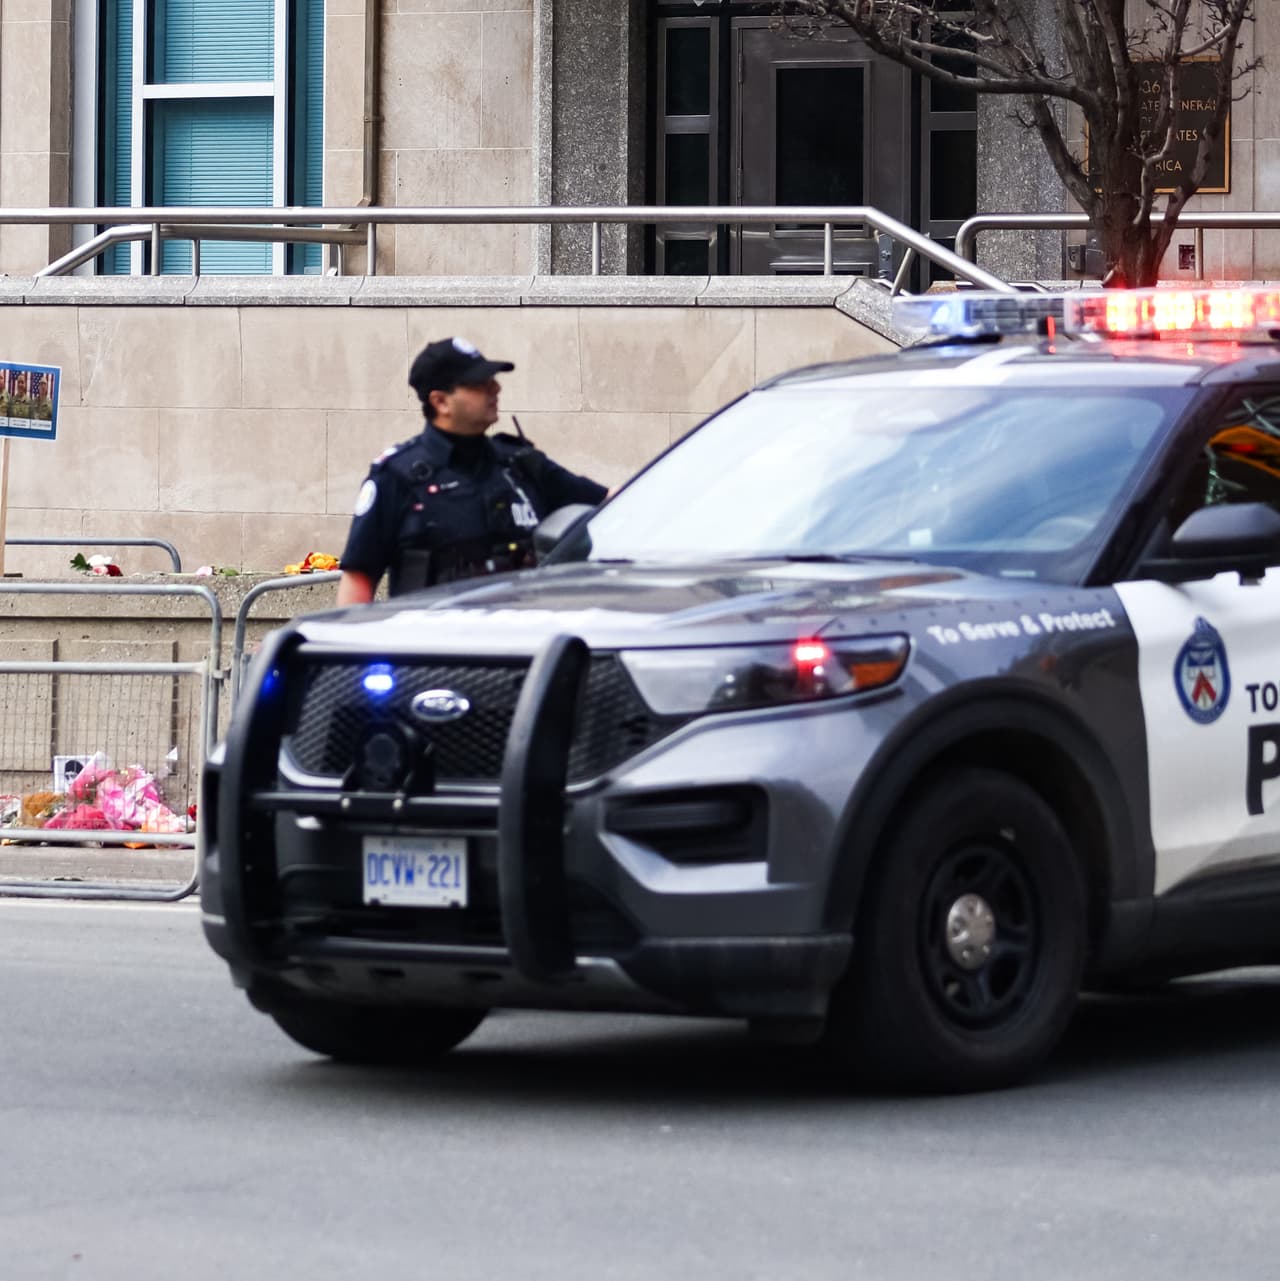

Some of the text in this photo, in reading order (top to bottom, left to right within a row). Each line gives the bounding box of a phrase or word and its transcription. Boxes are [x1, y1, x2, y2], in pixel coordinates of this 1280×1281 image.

[928, 608, 1115, 644] To Serve & Protect
